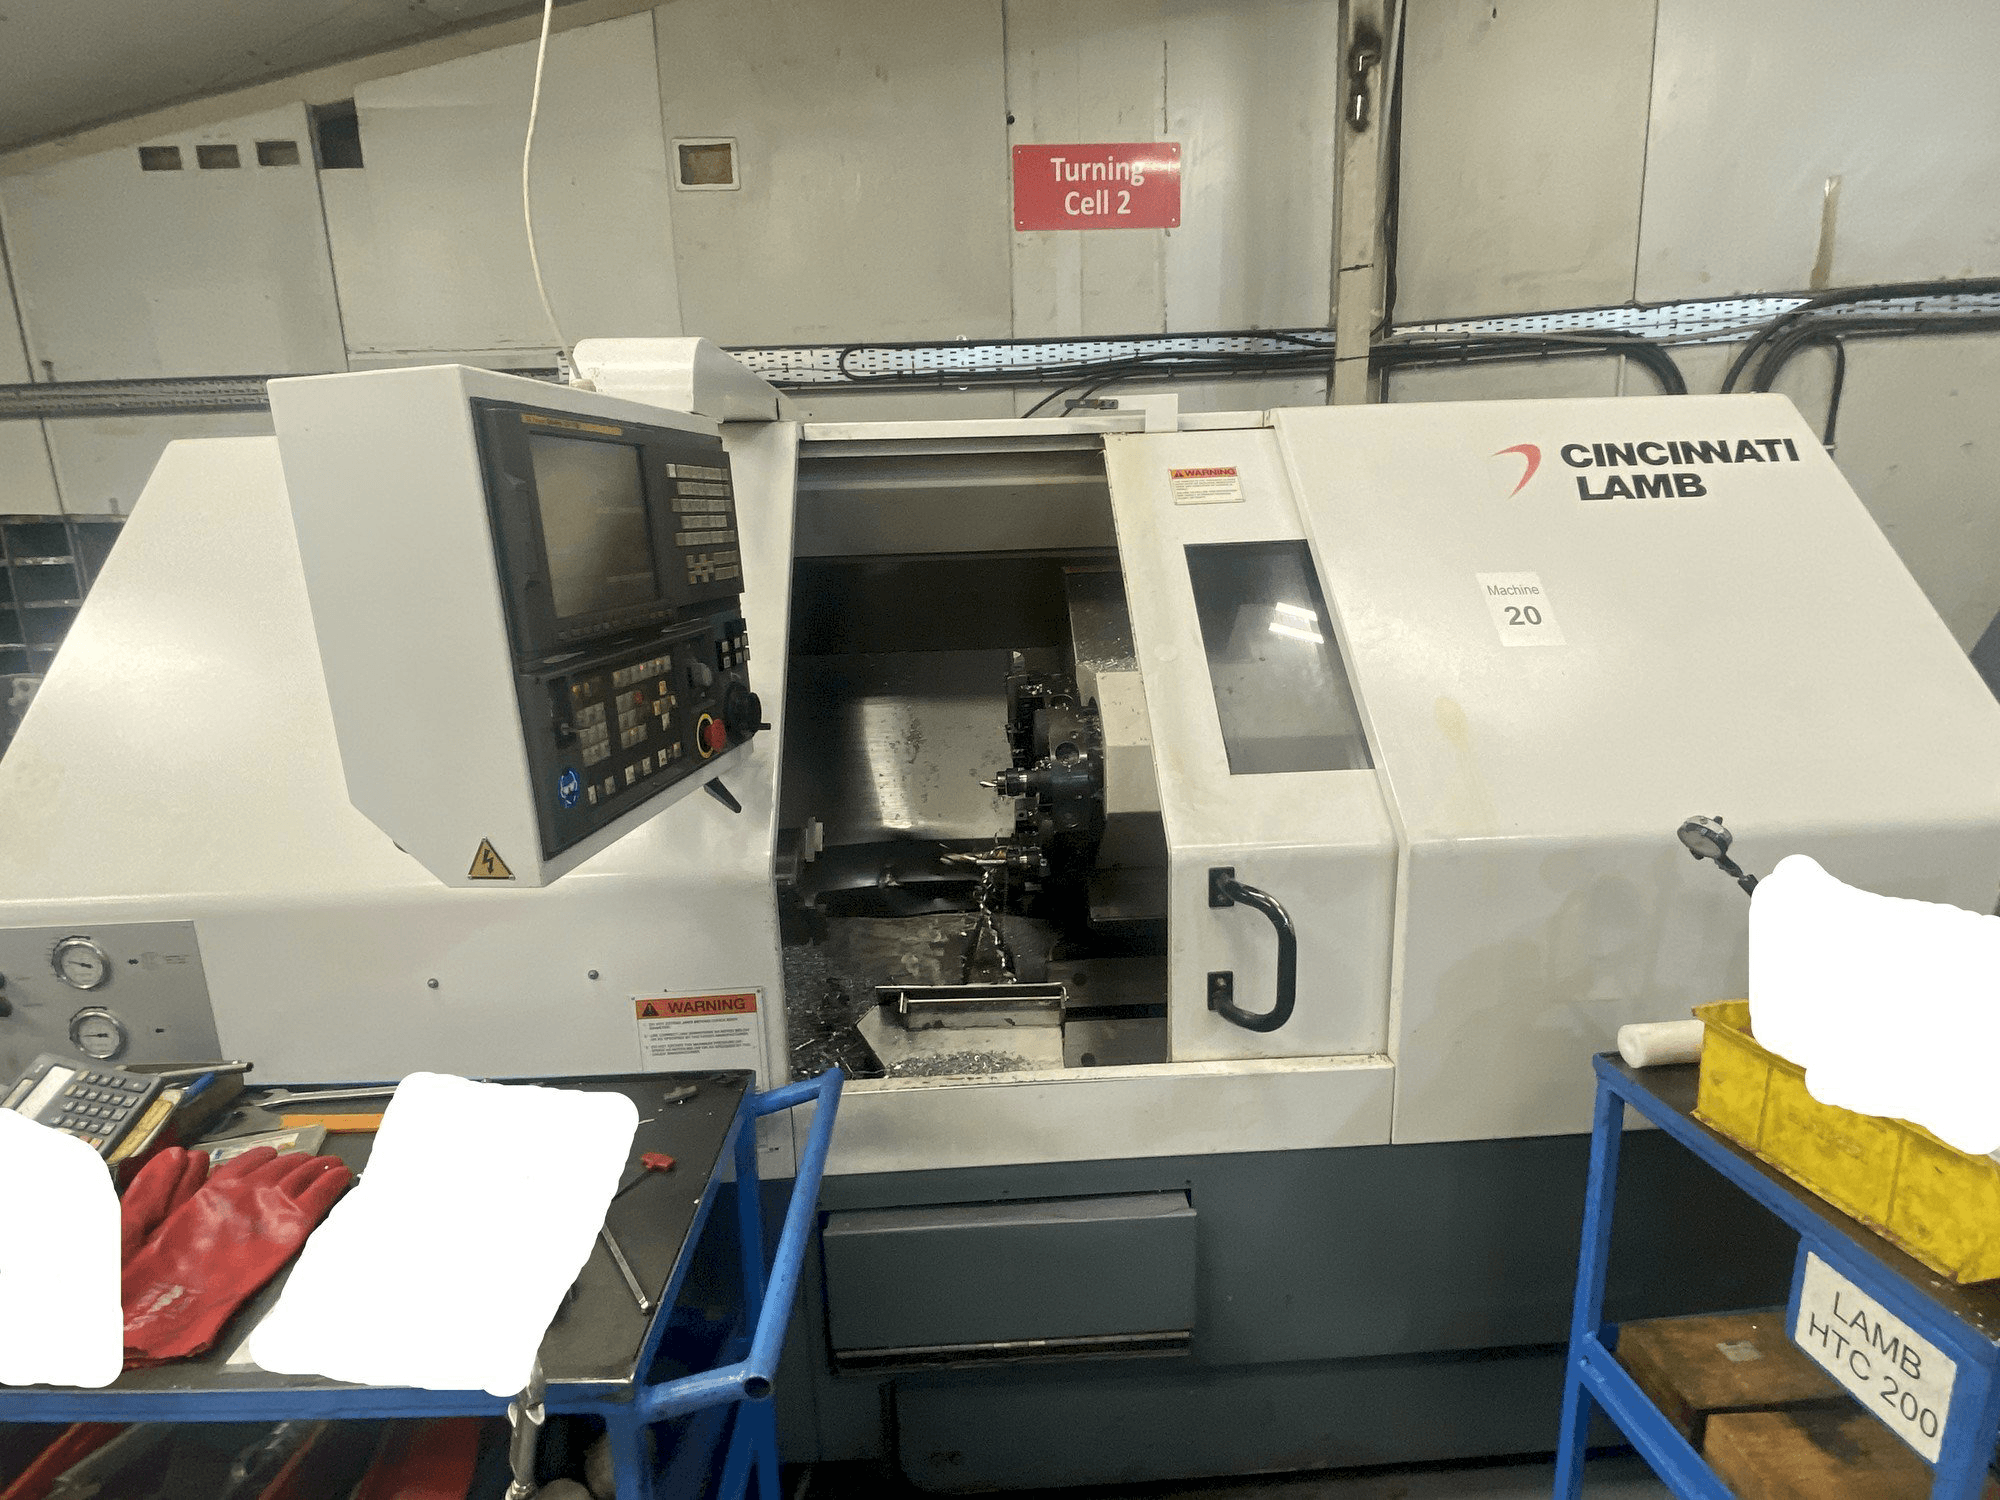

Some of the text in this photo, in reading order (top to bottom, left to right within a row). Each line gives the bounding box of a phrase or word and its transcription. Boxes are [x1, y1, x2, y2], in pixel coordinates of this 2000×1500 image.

[1050, 155, 1145, 187] Turning
[1064, 189, 1131, 216] Cell 2
[1560, 438, 1800, 468] CINCINNATI
[1185, 468, 1236, 477] WARNING
[1576, 473, 1708, 501] LAMB
[1486, 584, 1540, 597] Machine
[1503, 606, 1542, 626] 20
[668, 997, 746, 1013] WARNING
[1833, 1291, 1922, 1380] LAMB
[1809, 1311, 1938, 1438] HTC 200
